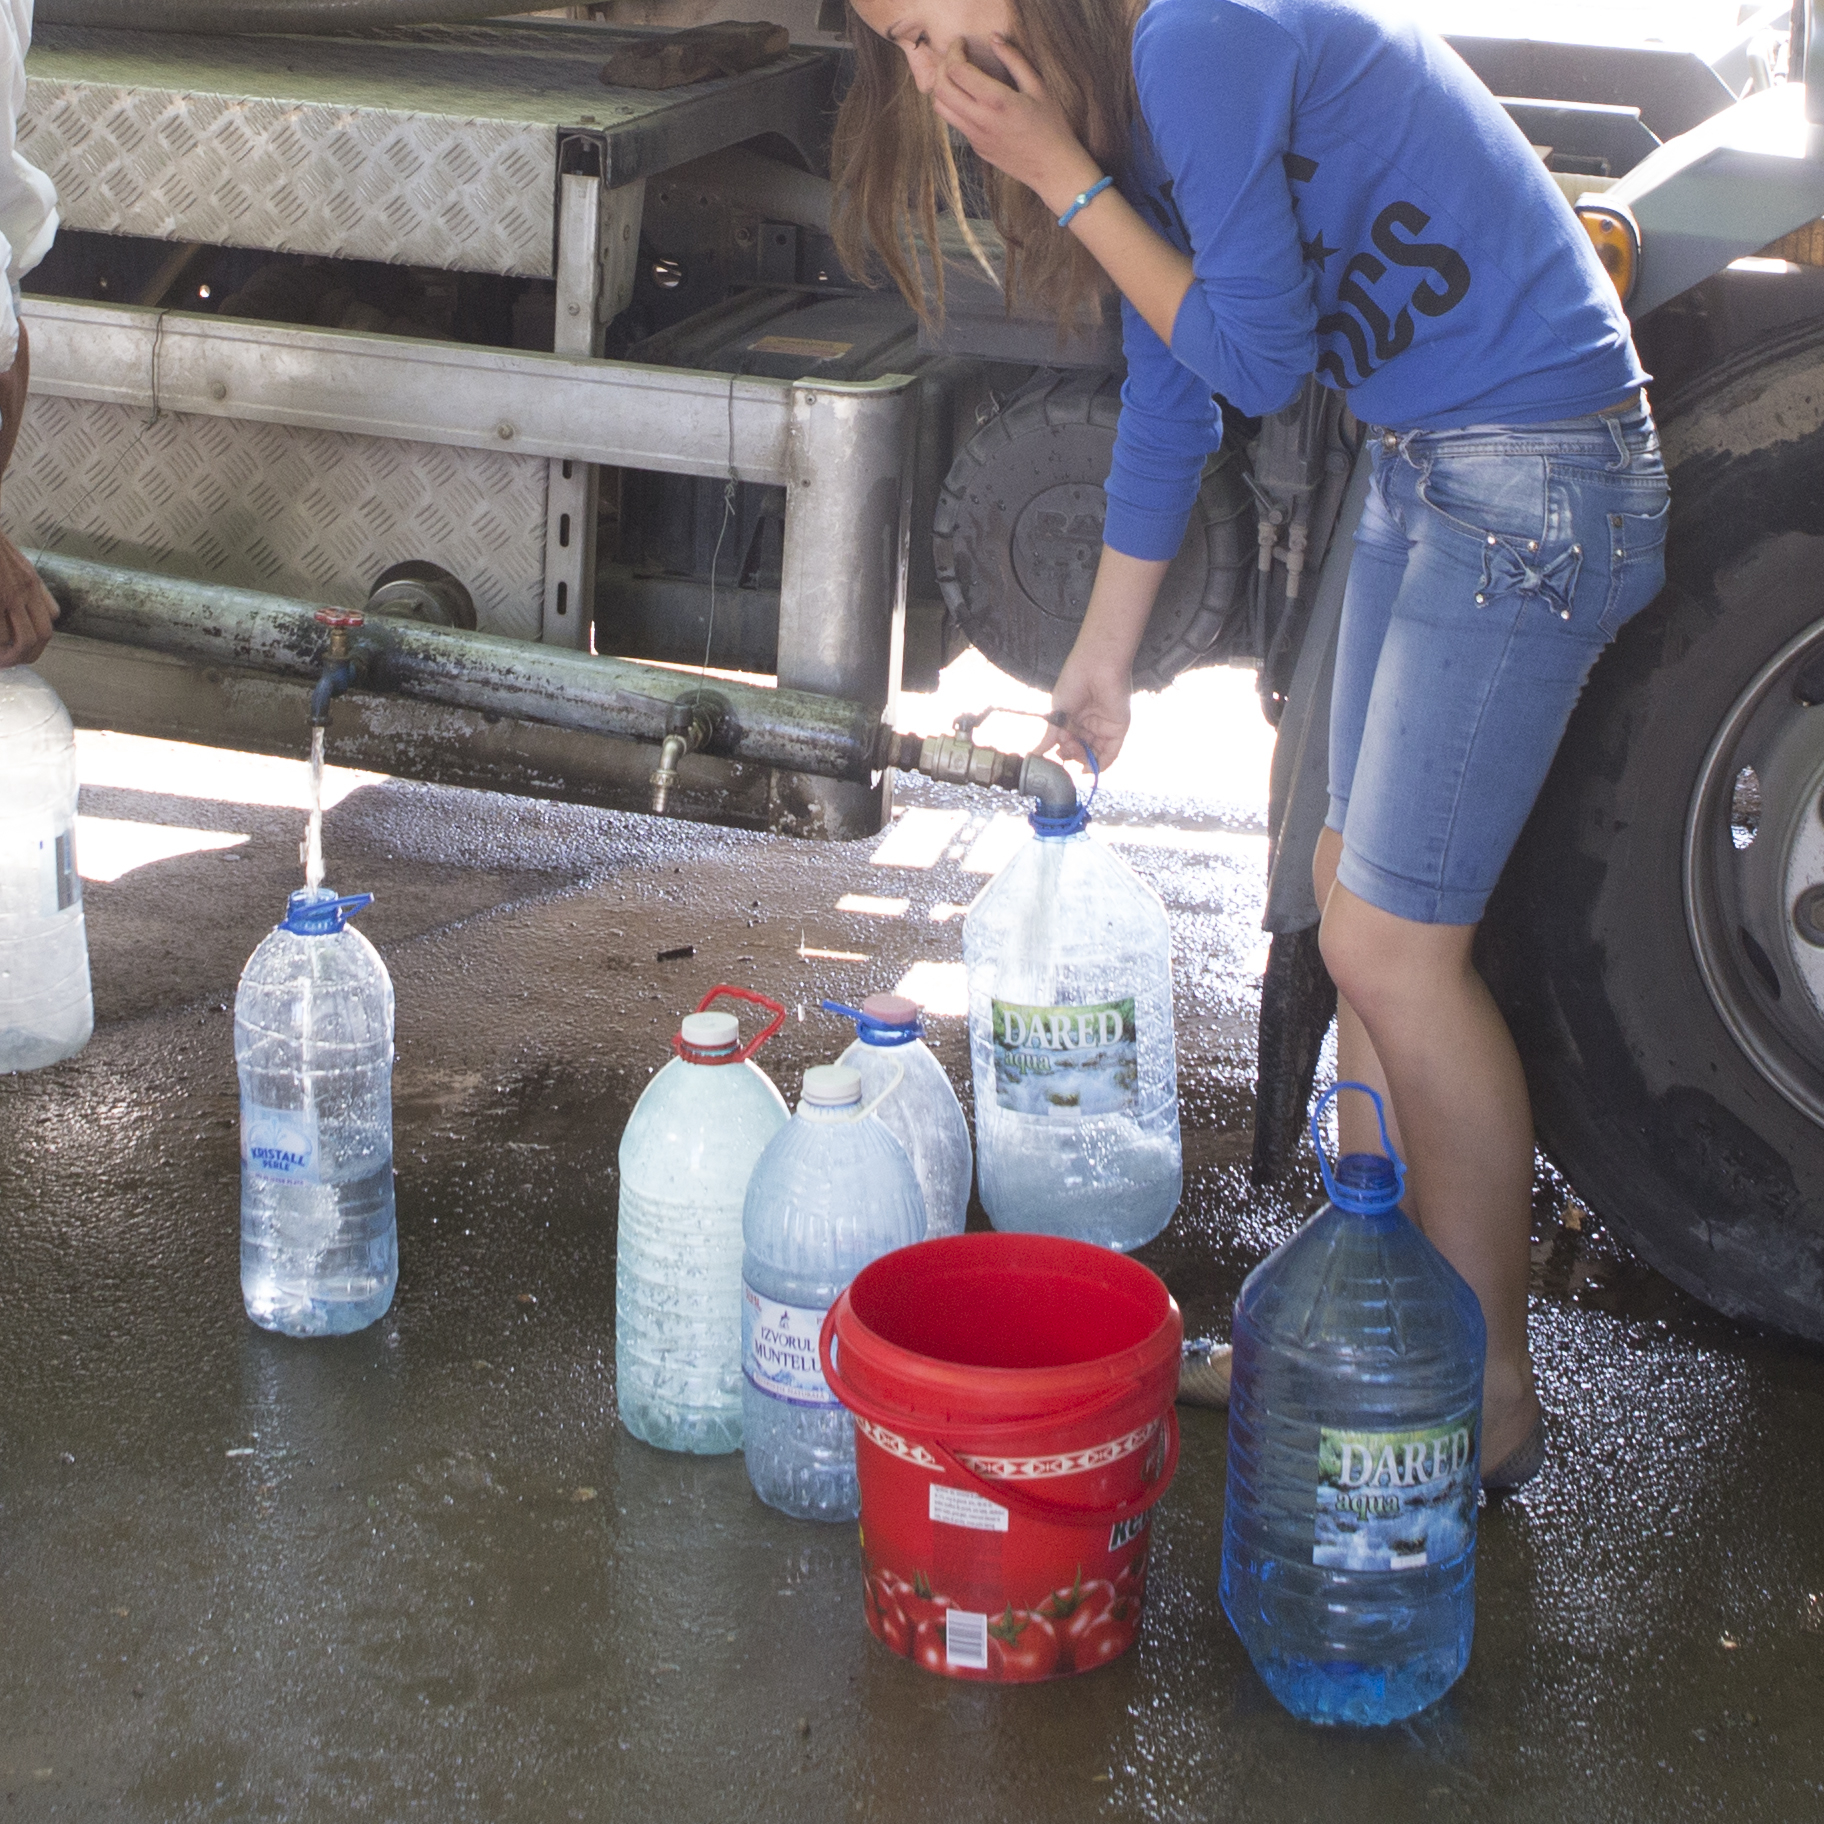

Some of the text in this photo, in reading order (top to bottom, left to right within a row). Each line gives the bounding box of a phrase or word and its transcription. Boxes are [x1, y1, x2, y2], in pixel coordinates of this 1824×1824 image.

[1003, 1009, 1125, 1050] DARED
[1004, 1050, 1052, 1075] aqua
[251, 1147, 305, 1167] KRISTALL
[761, 1326, 815, 1353] IZVORUL
[1337, 1428, 1469, 1488] DARED
[1336, 1491, 1400, 1523] aqua
